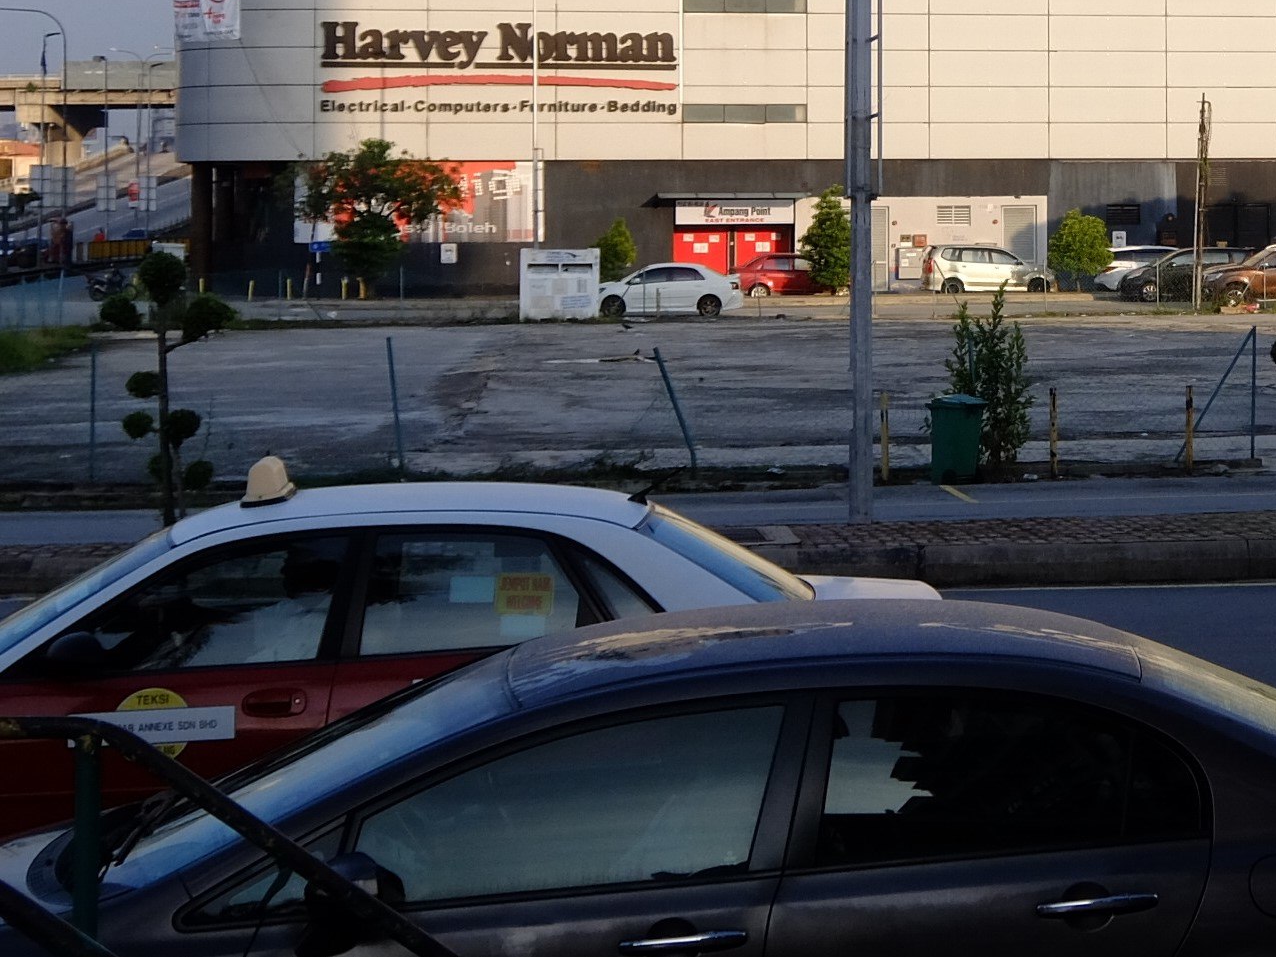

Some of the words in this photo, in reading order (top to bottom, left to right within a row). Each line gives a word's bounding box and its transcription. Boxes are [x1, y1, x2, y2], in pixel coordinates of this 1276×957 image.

[320, 21, 488, 69] Harvey
[496, 22, 677, 63] Norman
[718, 206, 749, 217] Ampang
[751, 206, 771, 216] Point
[445, 222, 497, 234] Boleh
[136, 694, 169, 705] TEKSI
[138, 721, 174, 732] ANNEXE
[177, 720, 196, 730] SDN
[198, 719, 218, 730] BHD
